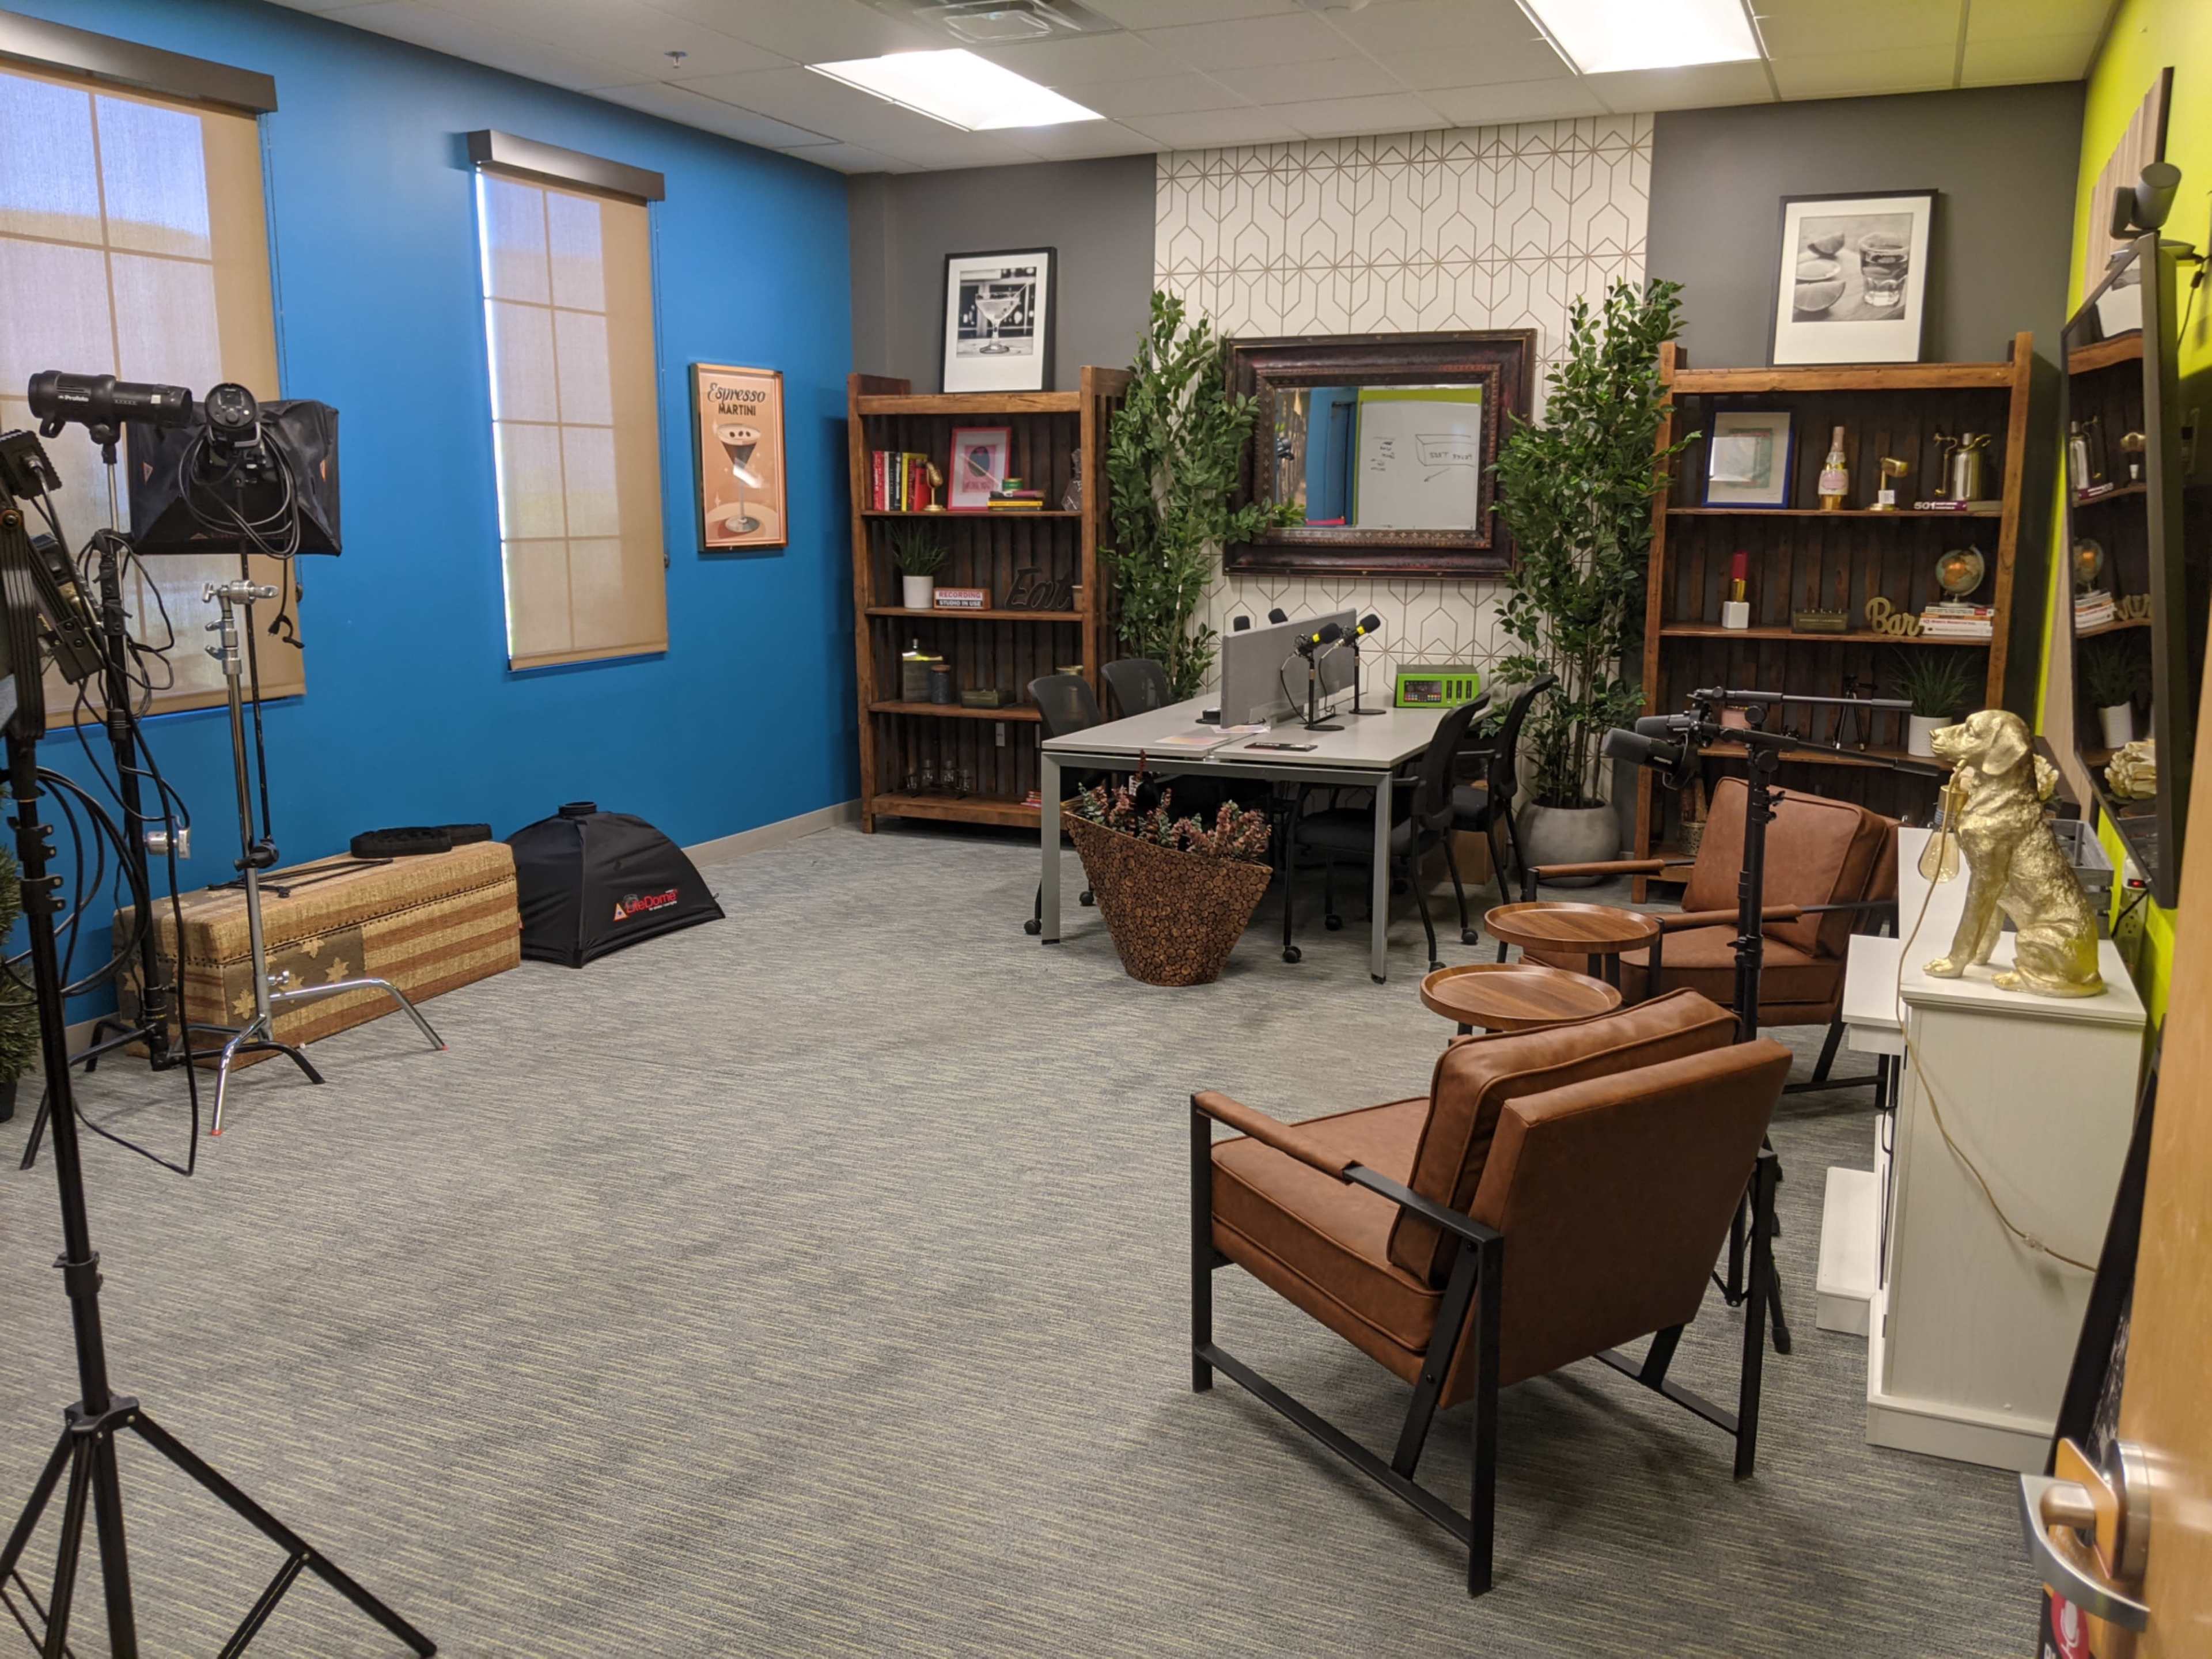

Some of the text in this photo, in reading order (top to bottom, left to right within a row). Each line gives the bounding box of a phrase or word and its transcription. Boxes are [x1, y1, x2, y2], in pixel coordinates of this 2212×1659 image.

[707, 382, 766, 404] Espresso
[718, 404, 756, 416] MARTINI
[1914, 501, 1936, 510] 501
[939, 590, 981, 599] RECORDING
[1005, 567, 1071, 609] Eat
[1865, 597, 1921, 636] Bar
